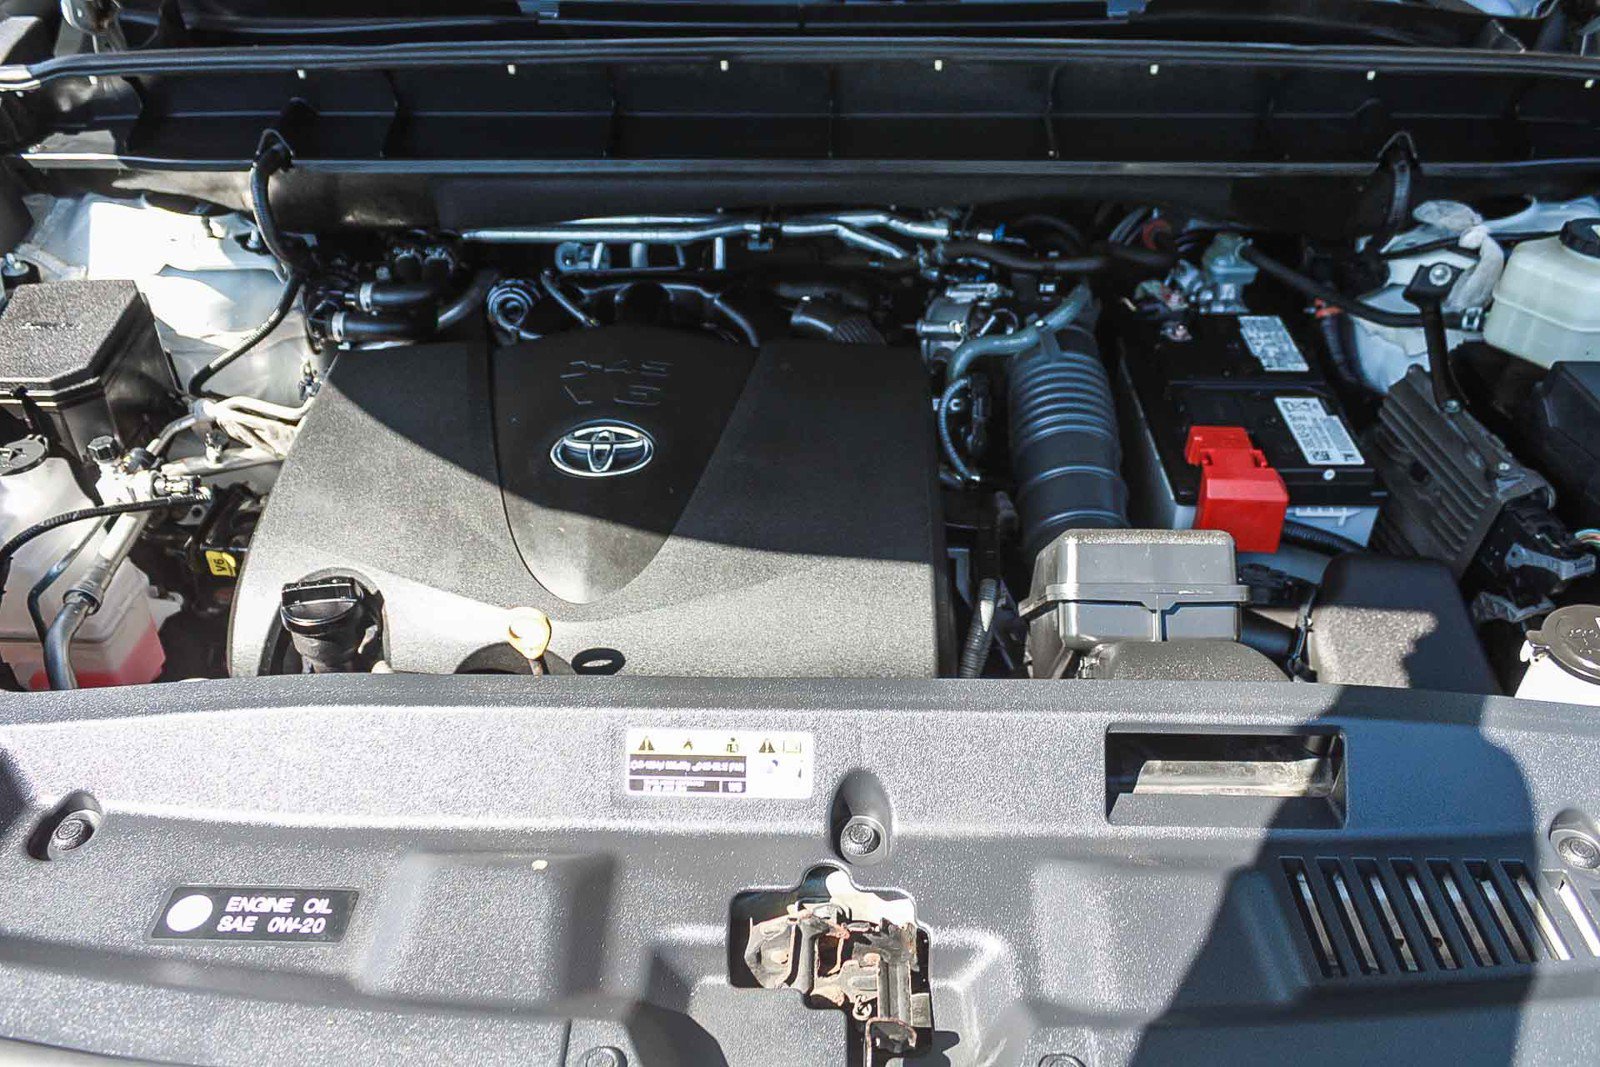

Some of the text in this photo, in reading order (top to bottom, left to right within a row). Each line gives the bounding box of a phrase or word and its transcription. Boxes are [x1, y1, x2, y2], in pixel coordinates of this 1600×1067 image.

[213, 559, 227, 572] V6
[225, 897, 333, 914] ENGINE OIL
[216, 916, 326, 933] SAE 0W-20
